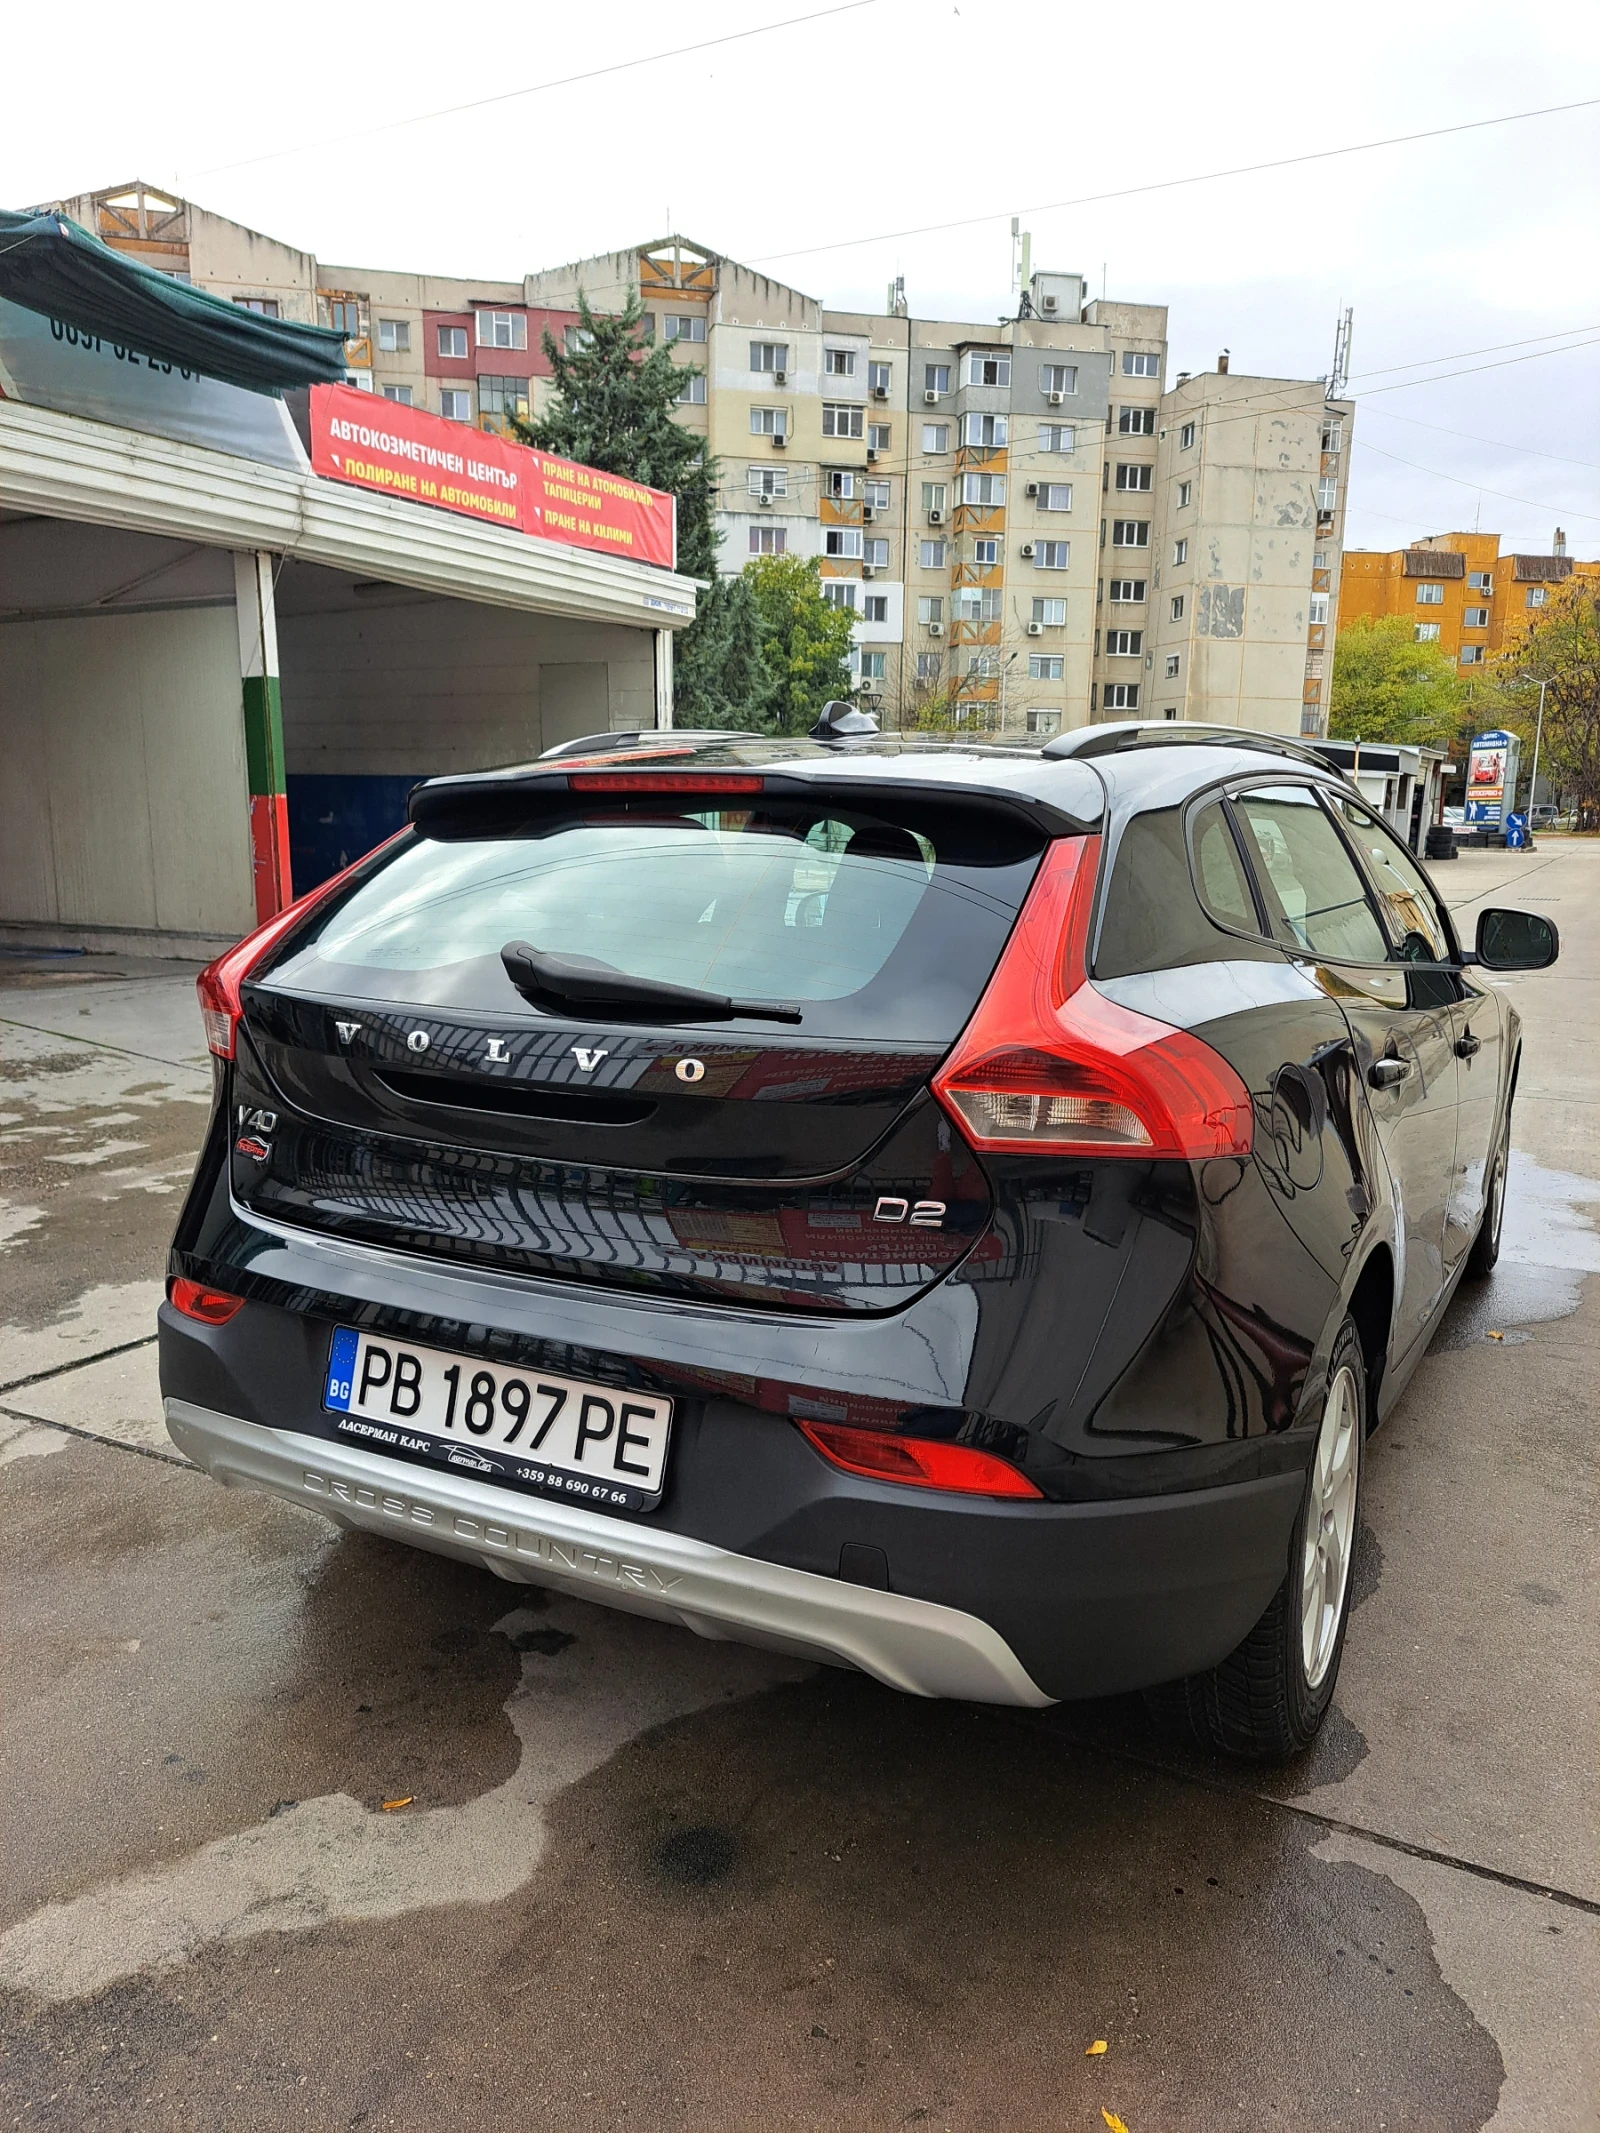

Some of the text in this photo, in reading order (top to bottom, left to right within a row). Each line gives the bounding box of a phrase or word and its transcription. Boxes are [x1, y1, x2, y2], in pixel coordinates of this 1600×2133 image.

[330, 417, 517, 490] АВТОКОЗМЕТИЧЕН ЦЕНТЪР
[345, 458, 517, 520] ПОЛИРАНЕ НА АВТОМОБИЛИ
[542, 461, 575, 484] ПРАНЕ
[577, 472, 590, 487] НА
[543, 481, 602, 510] ТАПИЦЕРИИ
[545, 510, 633, 545] ПРАНЕ НА КИЛИМИ
[336, 1021, 706, 1083] VOLVO
[238, 1105, 278, 1132] V40
[873, 1196, 946, 1227] D2
[329, 1378, 350, 1400] BG
[358, 1345, 656, 1477] PB 1897 PE
[338, 1419, 431, 1452] ЛАСЕРМАН КАРС
[516, 1467, 628, 1504] +359 88 690 67 66
[302, 1470, 684, 1594] CROSS COUNTRY
